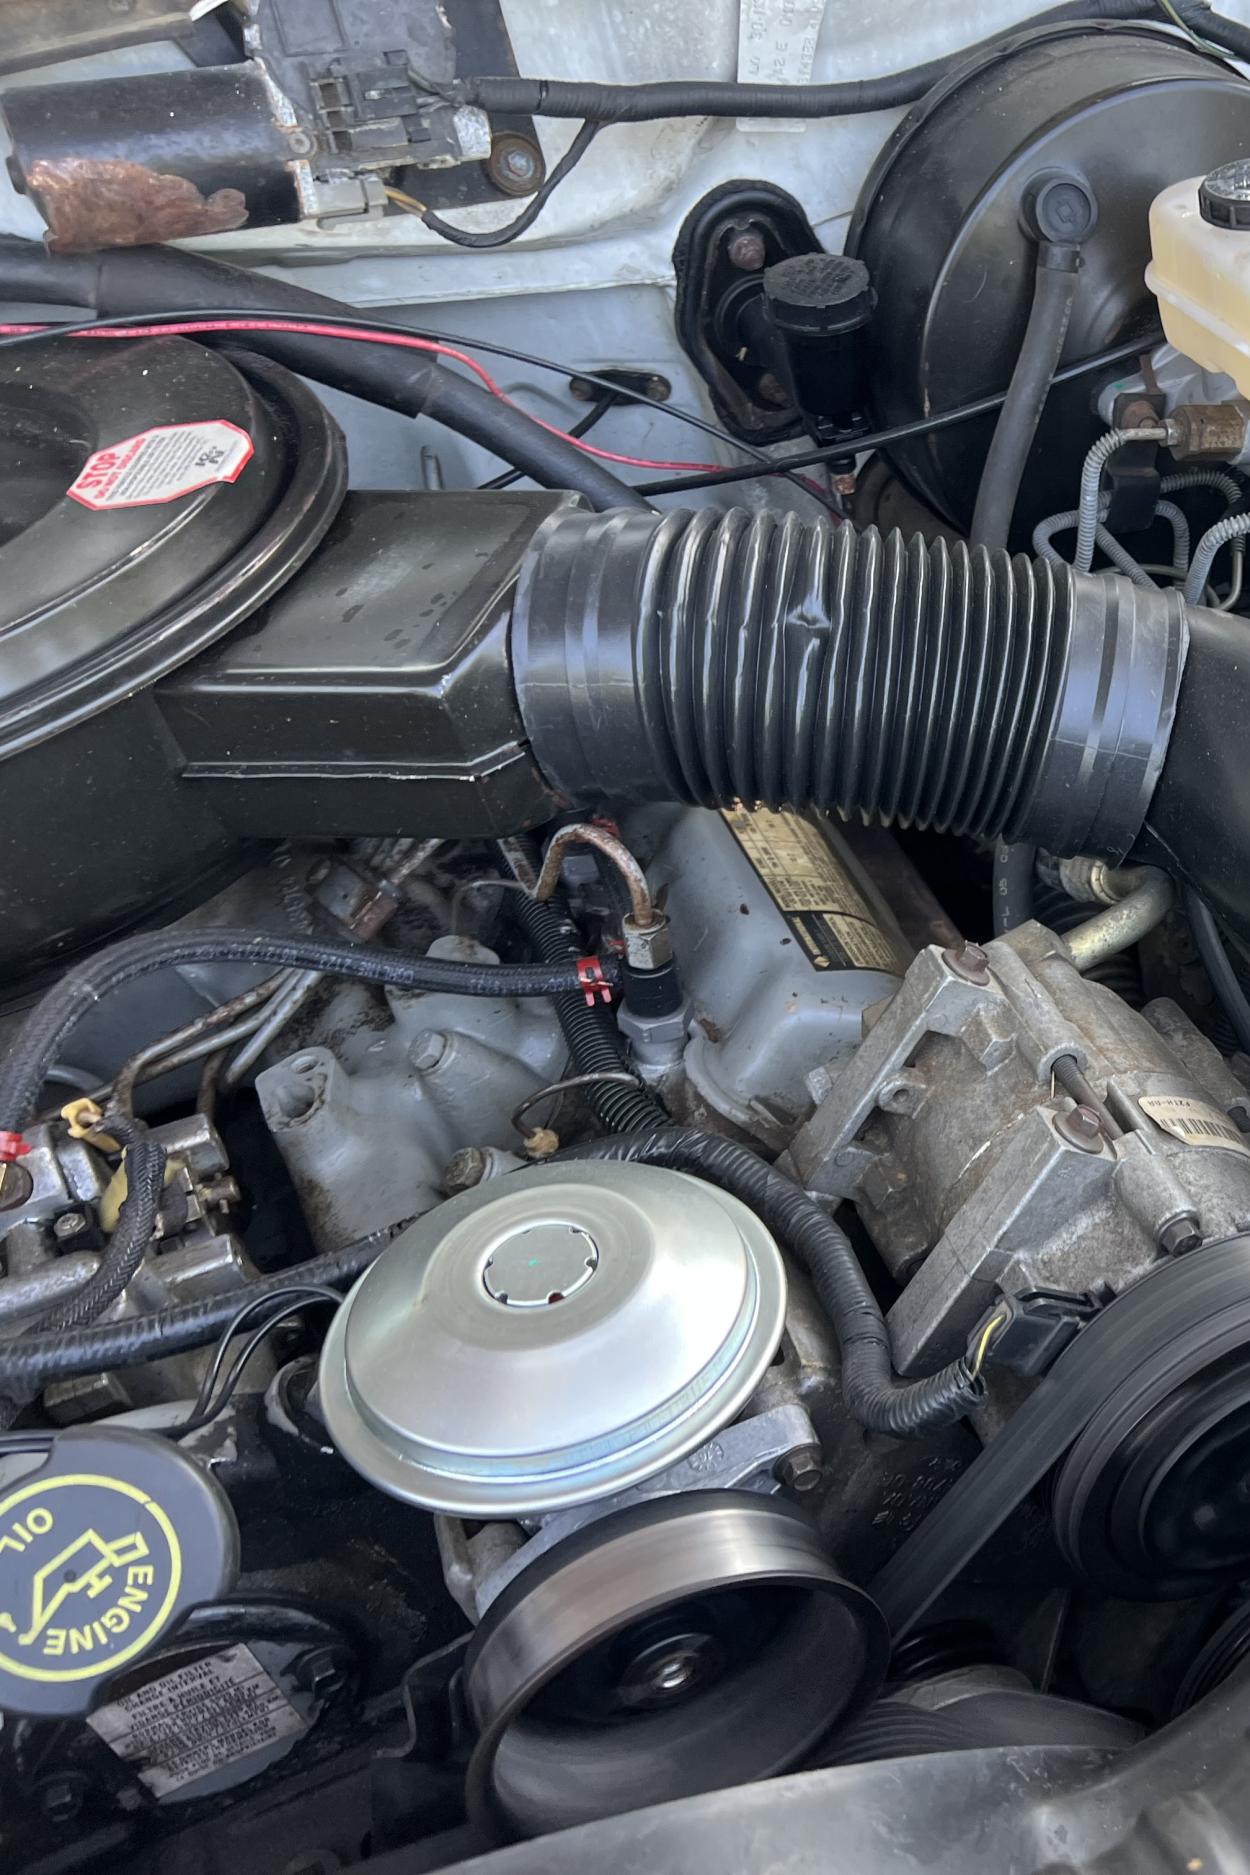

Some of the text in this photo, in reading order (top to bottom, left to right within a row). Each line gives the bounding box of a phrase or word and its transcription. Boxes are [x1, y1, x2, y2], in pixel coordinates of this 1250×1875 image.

[76, 452, 119, 489] STOP
[0, 1507, 53, 1552] OIL
[43, 1565, 154, 1656] ENGINE
